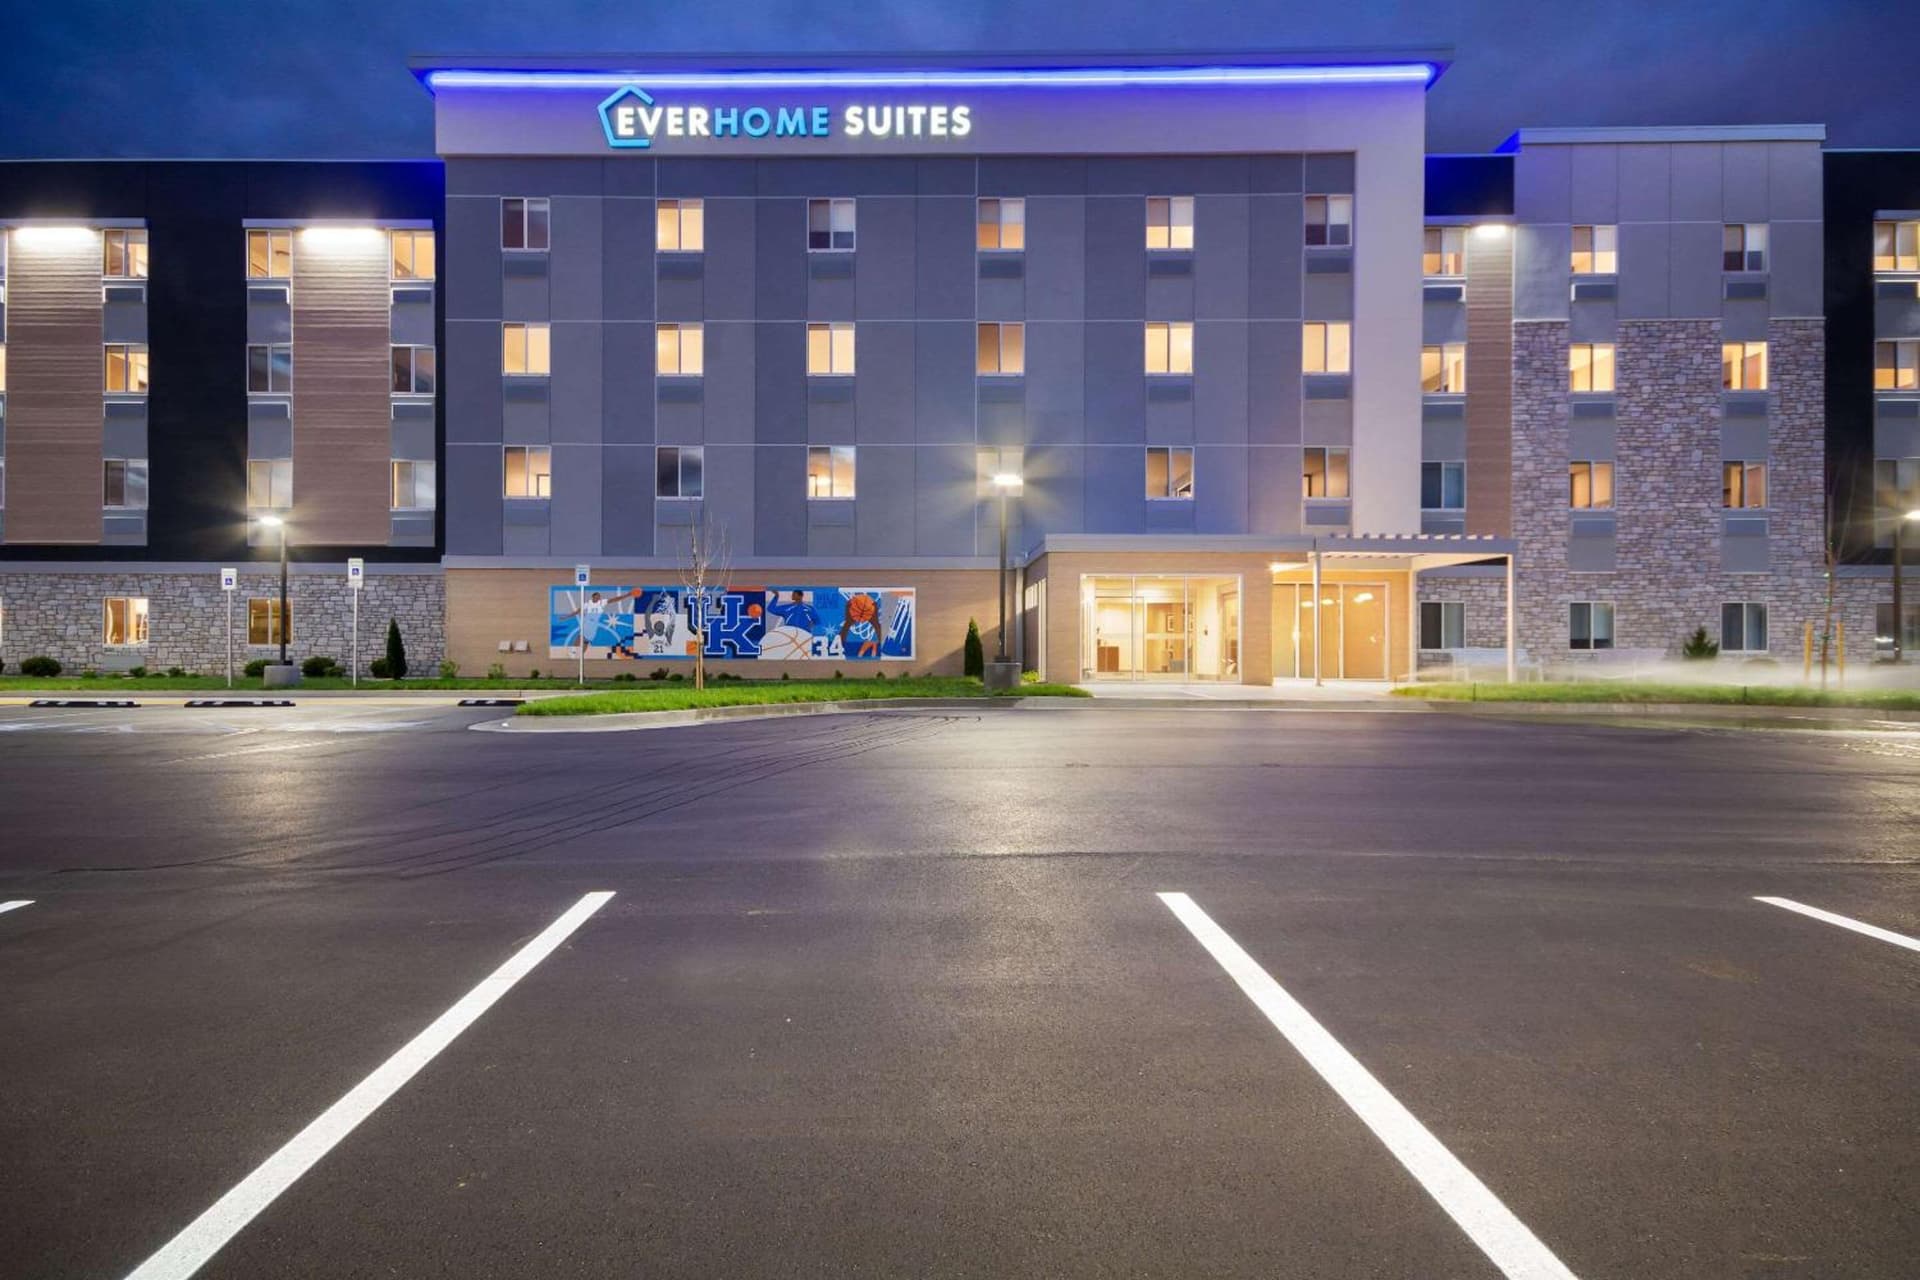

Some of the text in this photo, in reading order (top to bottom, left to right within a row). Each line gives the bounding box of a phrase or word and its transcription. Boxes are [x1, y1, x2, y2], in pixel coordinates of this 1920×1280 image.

[616, 106, 972, 136] EVERHOME SUITES
[688, 595, 761, 655] UK
[653, 644, 664, 654] 21
[810, 636, 846, 657] 34
